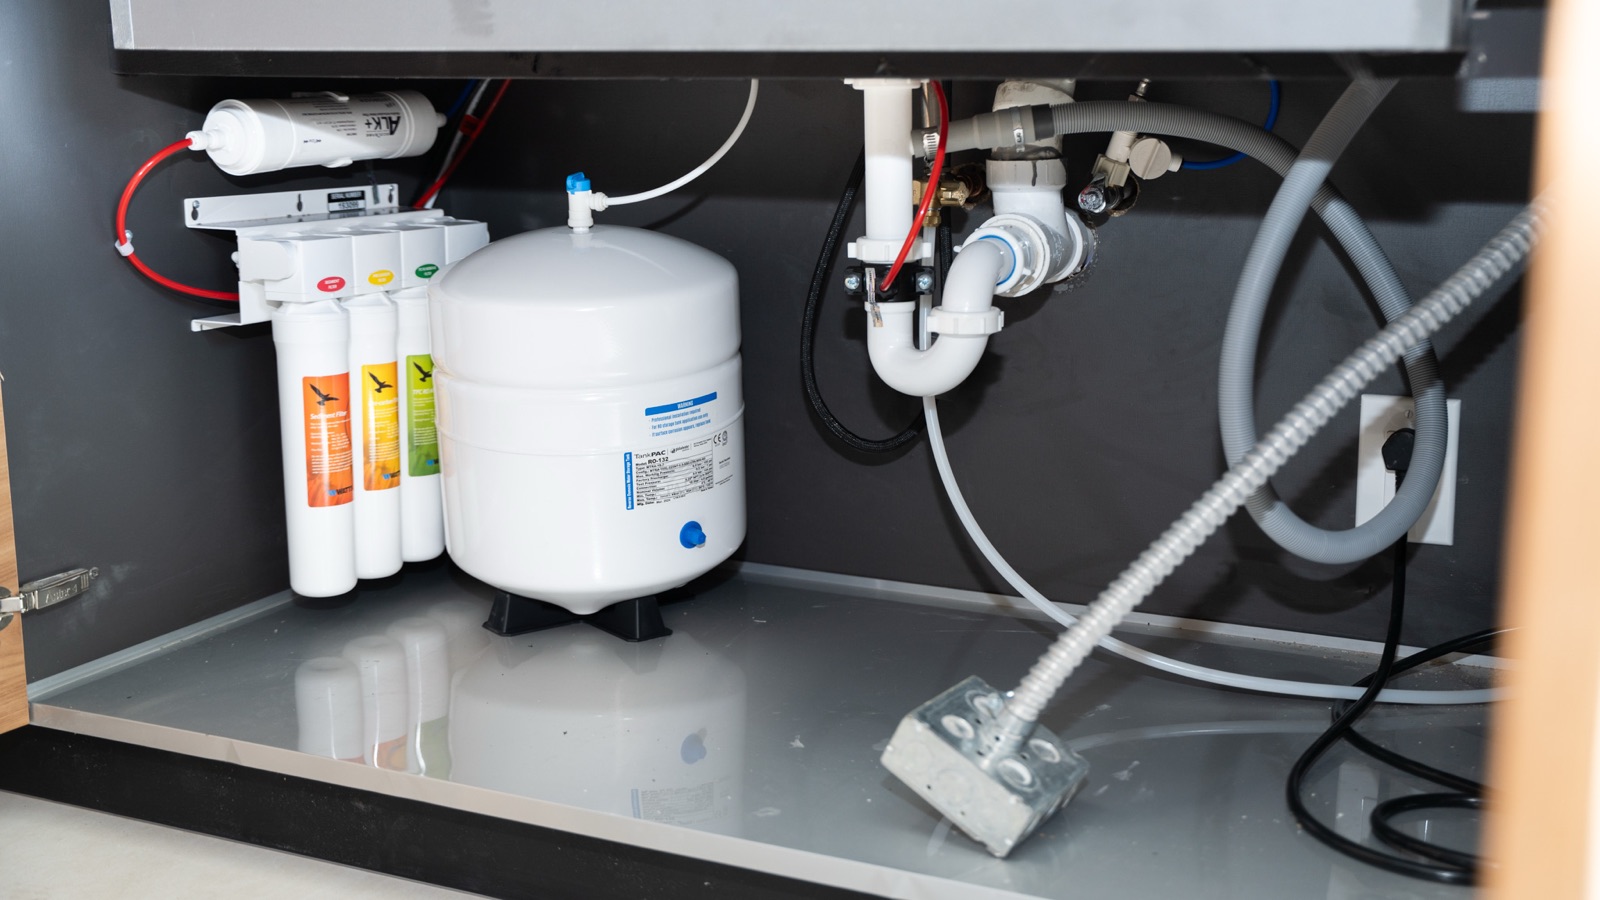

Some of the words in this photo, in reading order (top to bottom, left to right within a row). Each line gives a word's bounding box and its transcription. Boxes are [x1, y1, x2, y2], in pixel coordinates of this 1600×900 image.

[364, 115, 401, 136] ALK+
[677, 400, 694, 409] WARNING
[651, 415, 672, 423] Professional
[672, 411, 690, 419] installation
[713, 432, 722, 445] CE
[634, 449, 666, 460] TankPAC
[647, 456, 669, 465] RO-132
